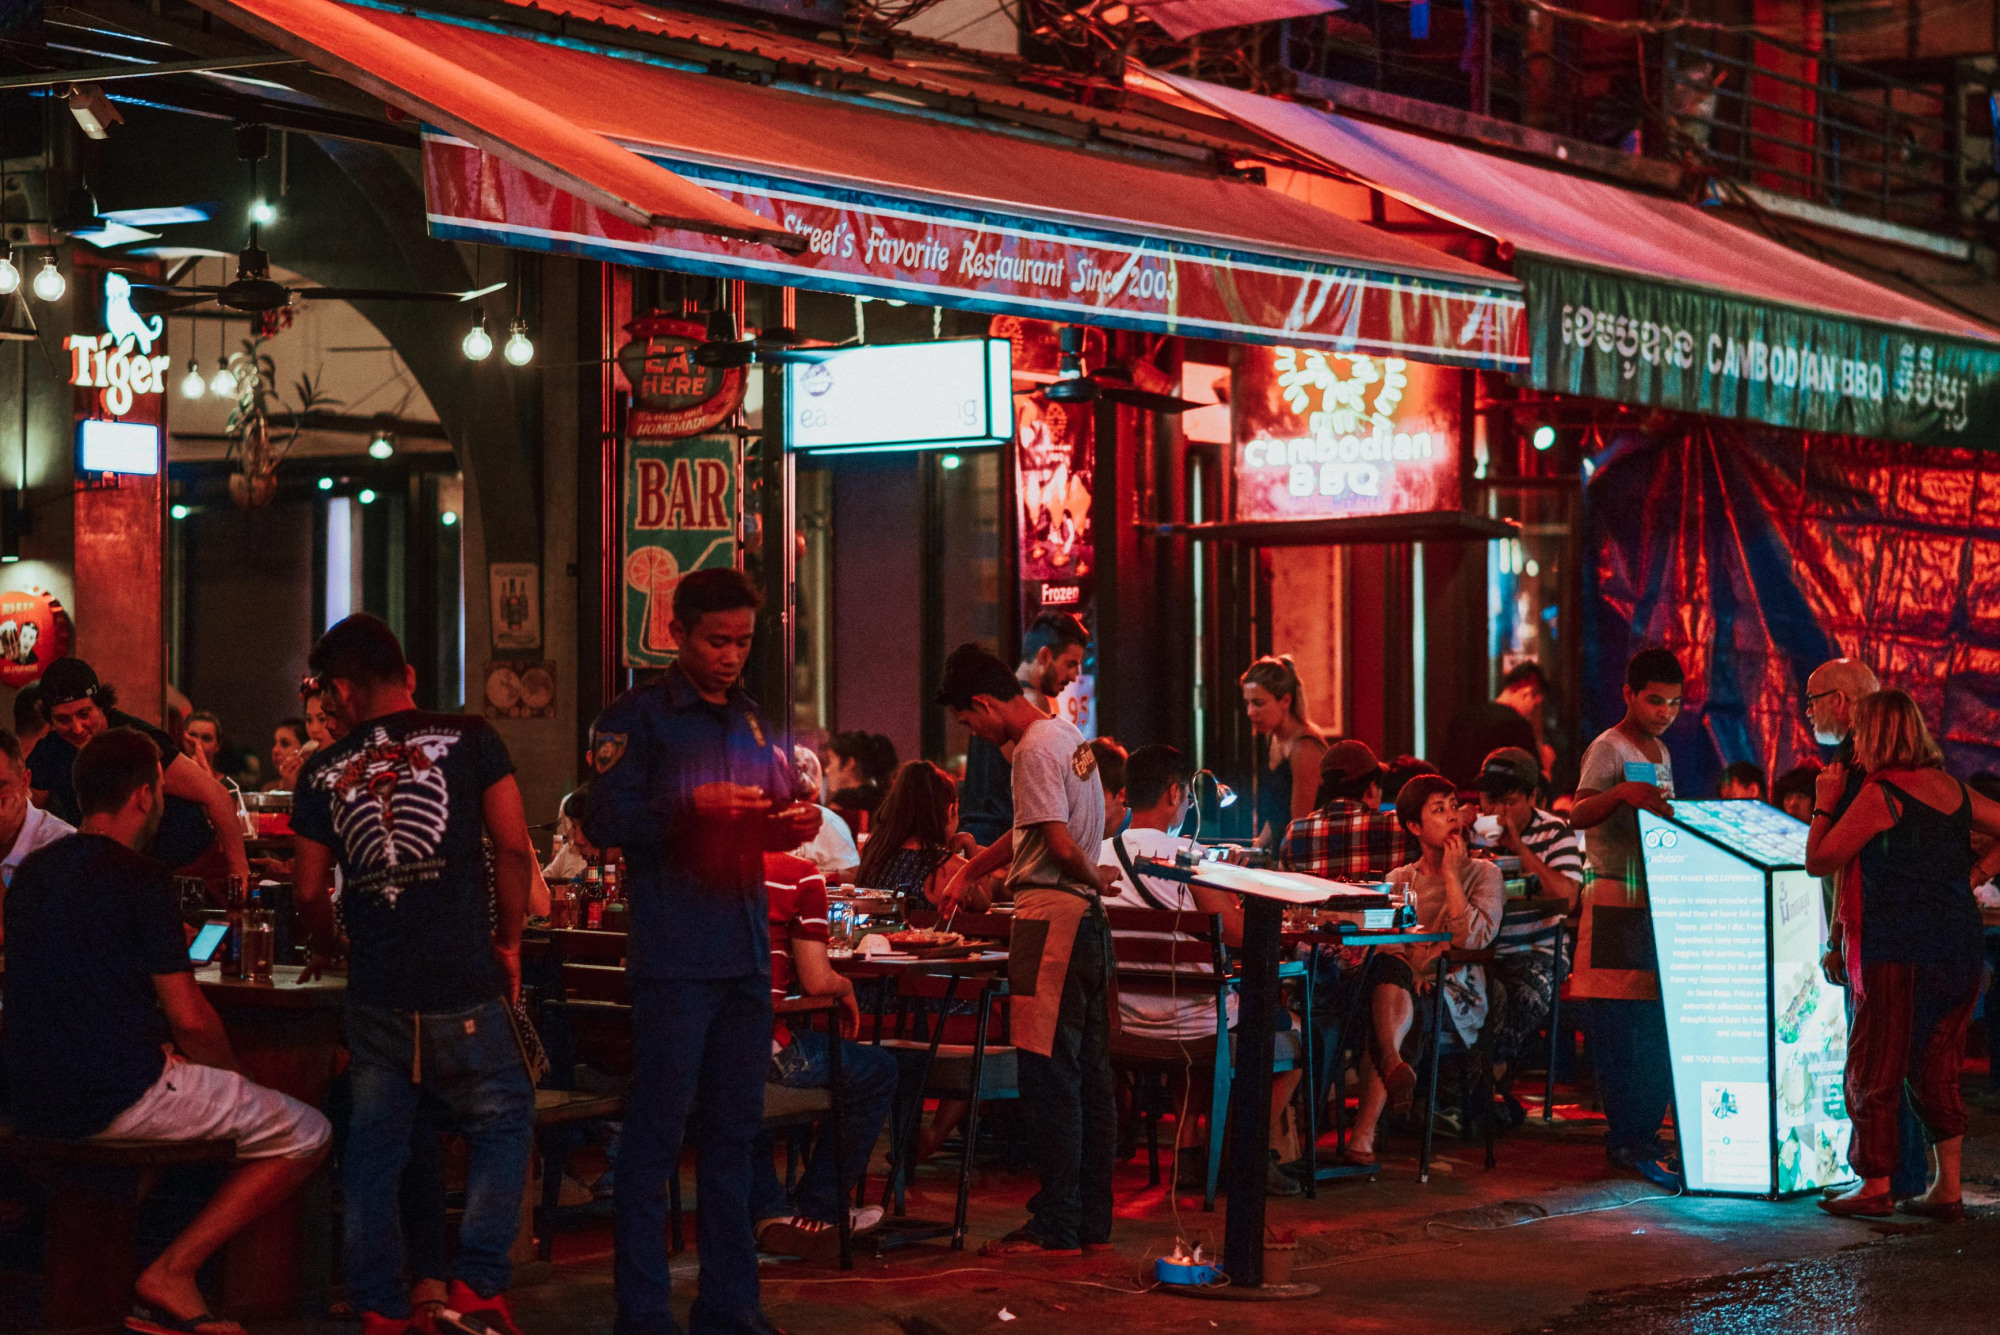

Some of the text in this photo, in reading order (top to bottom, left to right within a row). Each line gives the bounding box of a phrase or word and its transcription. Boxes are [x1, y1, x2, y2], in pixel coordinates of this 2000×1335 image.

[864, 225, 951, 272] Favorite
[958, 239, 1065, 288] Restaurant
[68, 332, 171, 416] Tiger
[641, 375, 707, 395] HERE
[1706, 333, 1884, 405] CAMBODIAN BBQ
[635, 458, 733, 531] BAR
[1288, 462, 1381, 497] BBQ
[1041, 583, 1080, 602] Frozen
